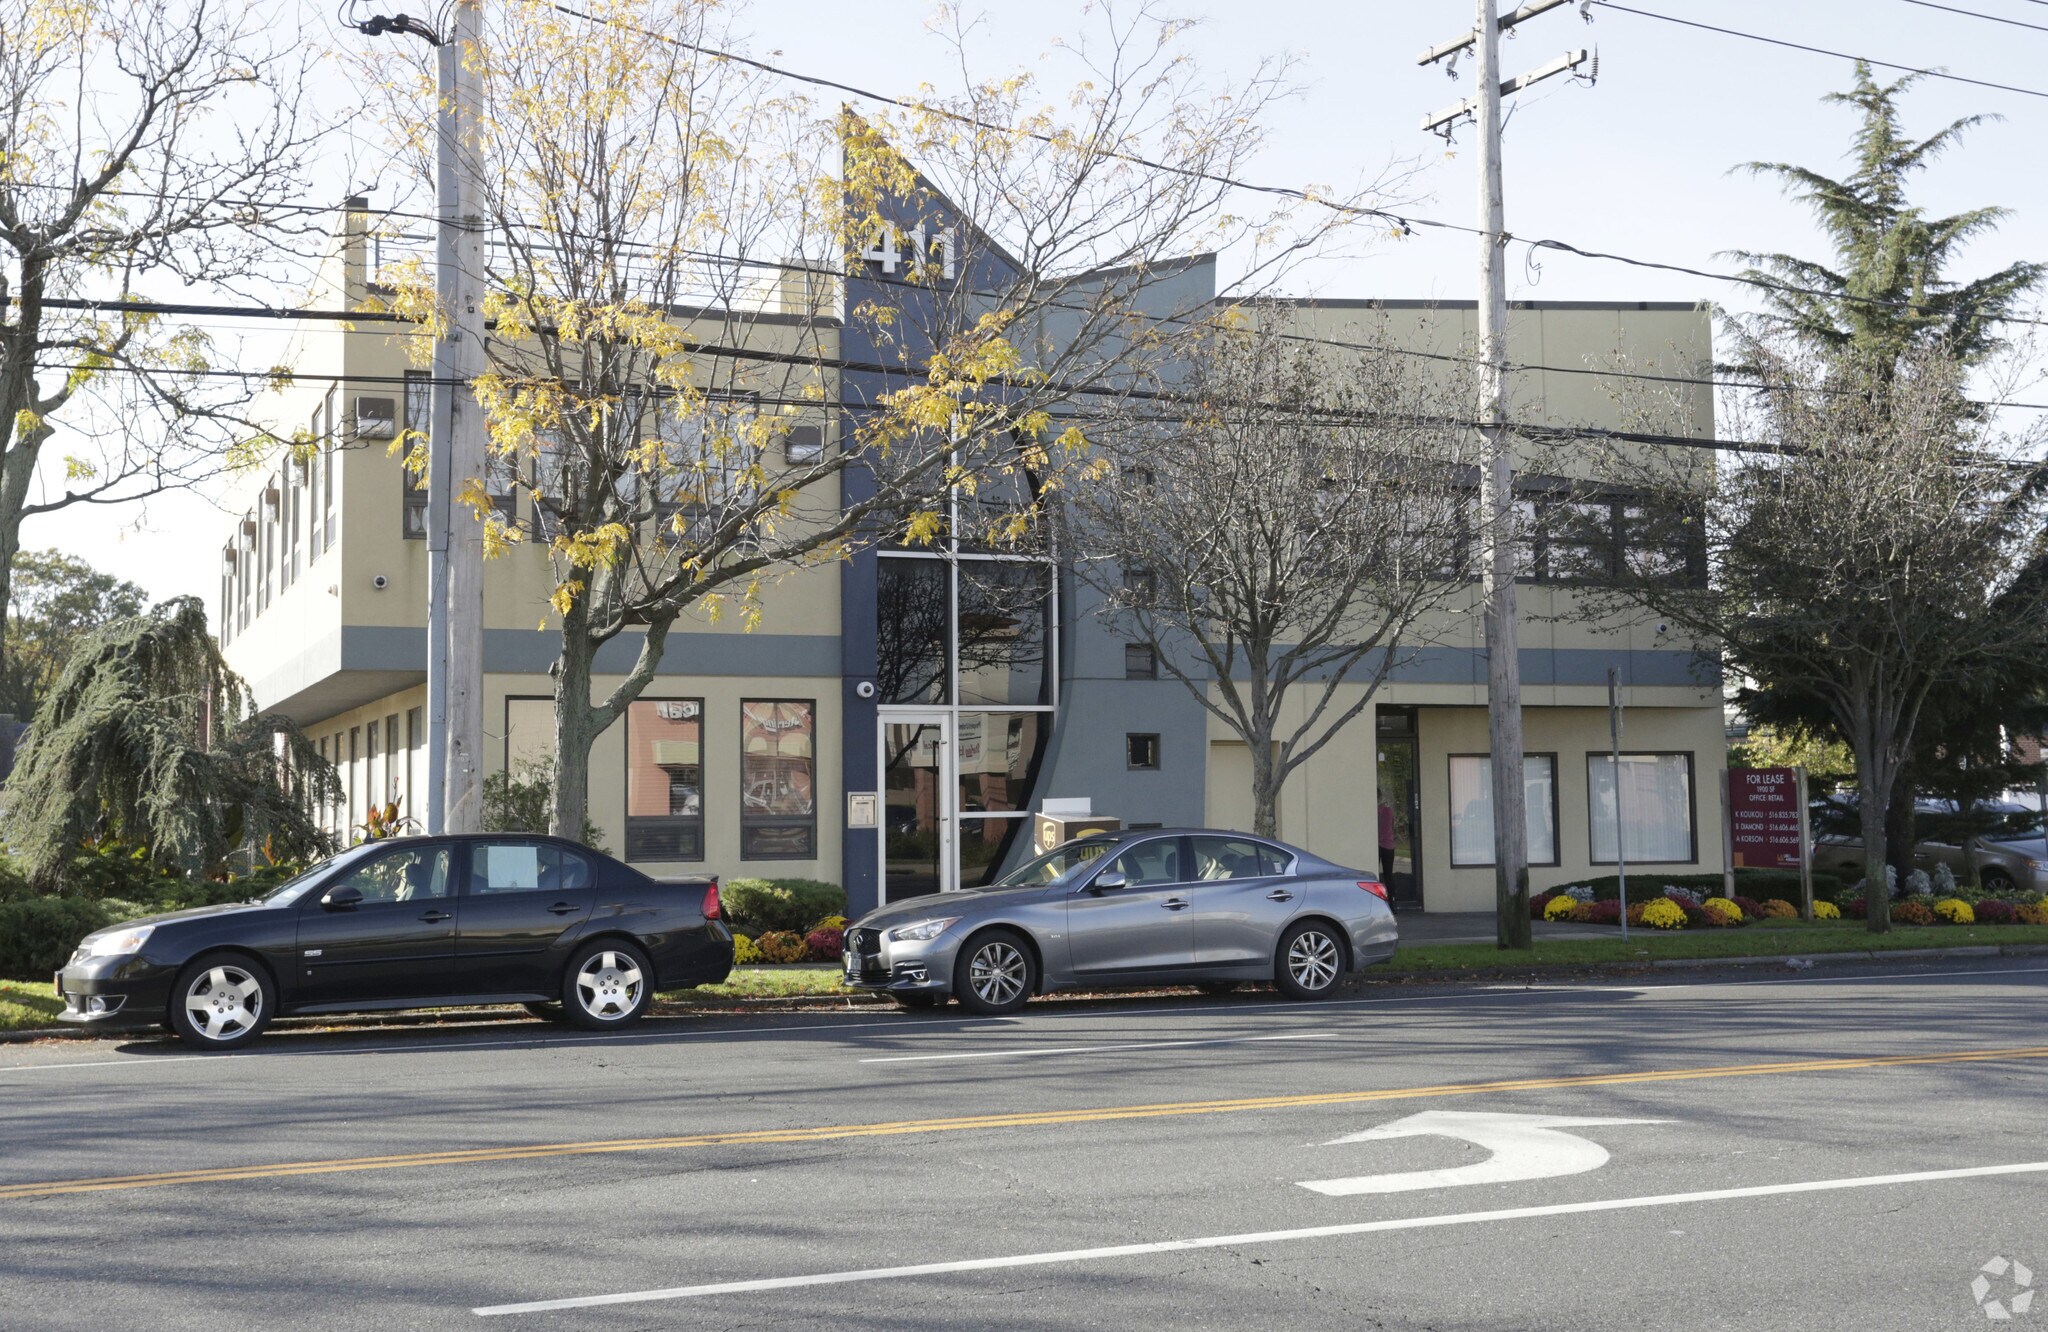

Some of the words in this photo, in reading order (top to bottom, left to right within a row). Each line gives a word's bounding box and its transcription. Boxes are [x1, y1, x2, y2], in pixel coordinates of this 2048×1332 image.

[862, 219, 955, 280] 411
[1746, 774, 1760, 784] FOR
[1762, 774, 1784, 784] LEASE
